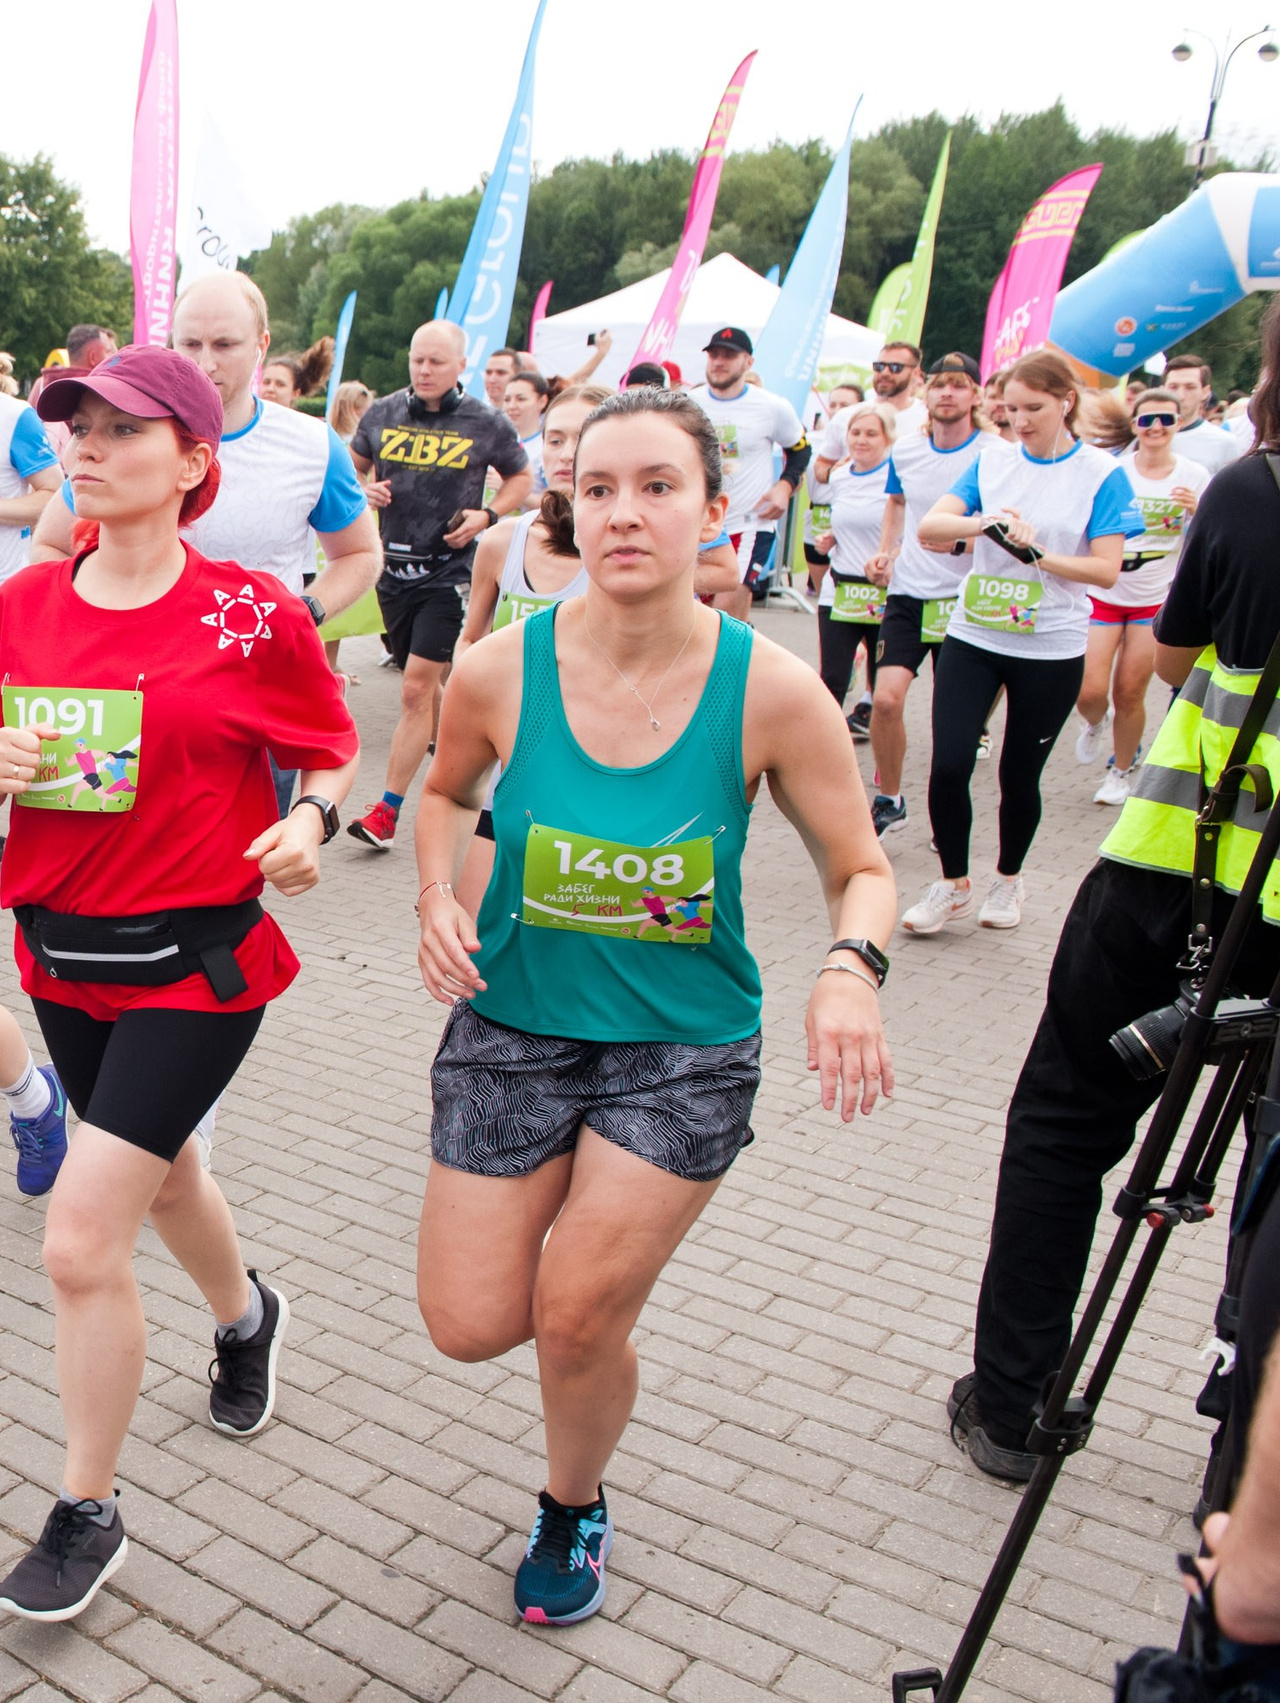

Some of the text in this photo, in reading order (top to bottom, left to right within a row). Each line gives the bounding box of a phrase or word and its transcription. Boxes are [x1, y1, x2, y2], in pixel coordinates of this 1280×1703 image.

[379, 428, 473, 469] ZBZ
[844, 584, 880, 601] 1002
[978, 579, 1029, 602] 1098
[14, 696, 104, 736] 1091
[554, 840, 685, 886] 1408
[543, 893, 574, 903] РАДИ
[557, 883, 596, 894] ЗАБЕГ
[571, 903, 587, 916] 5
